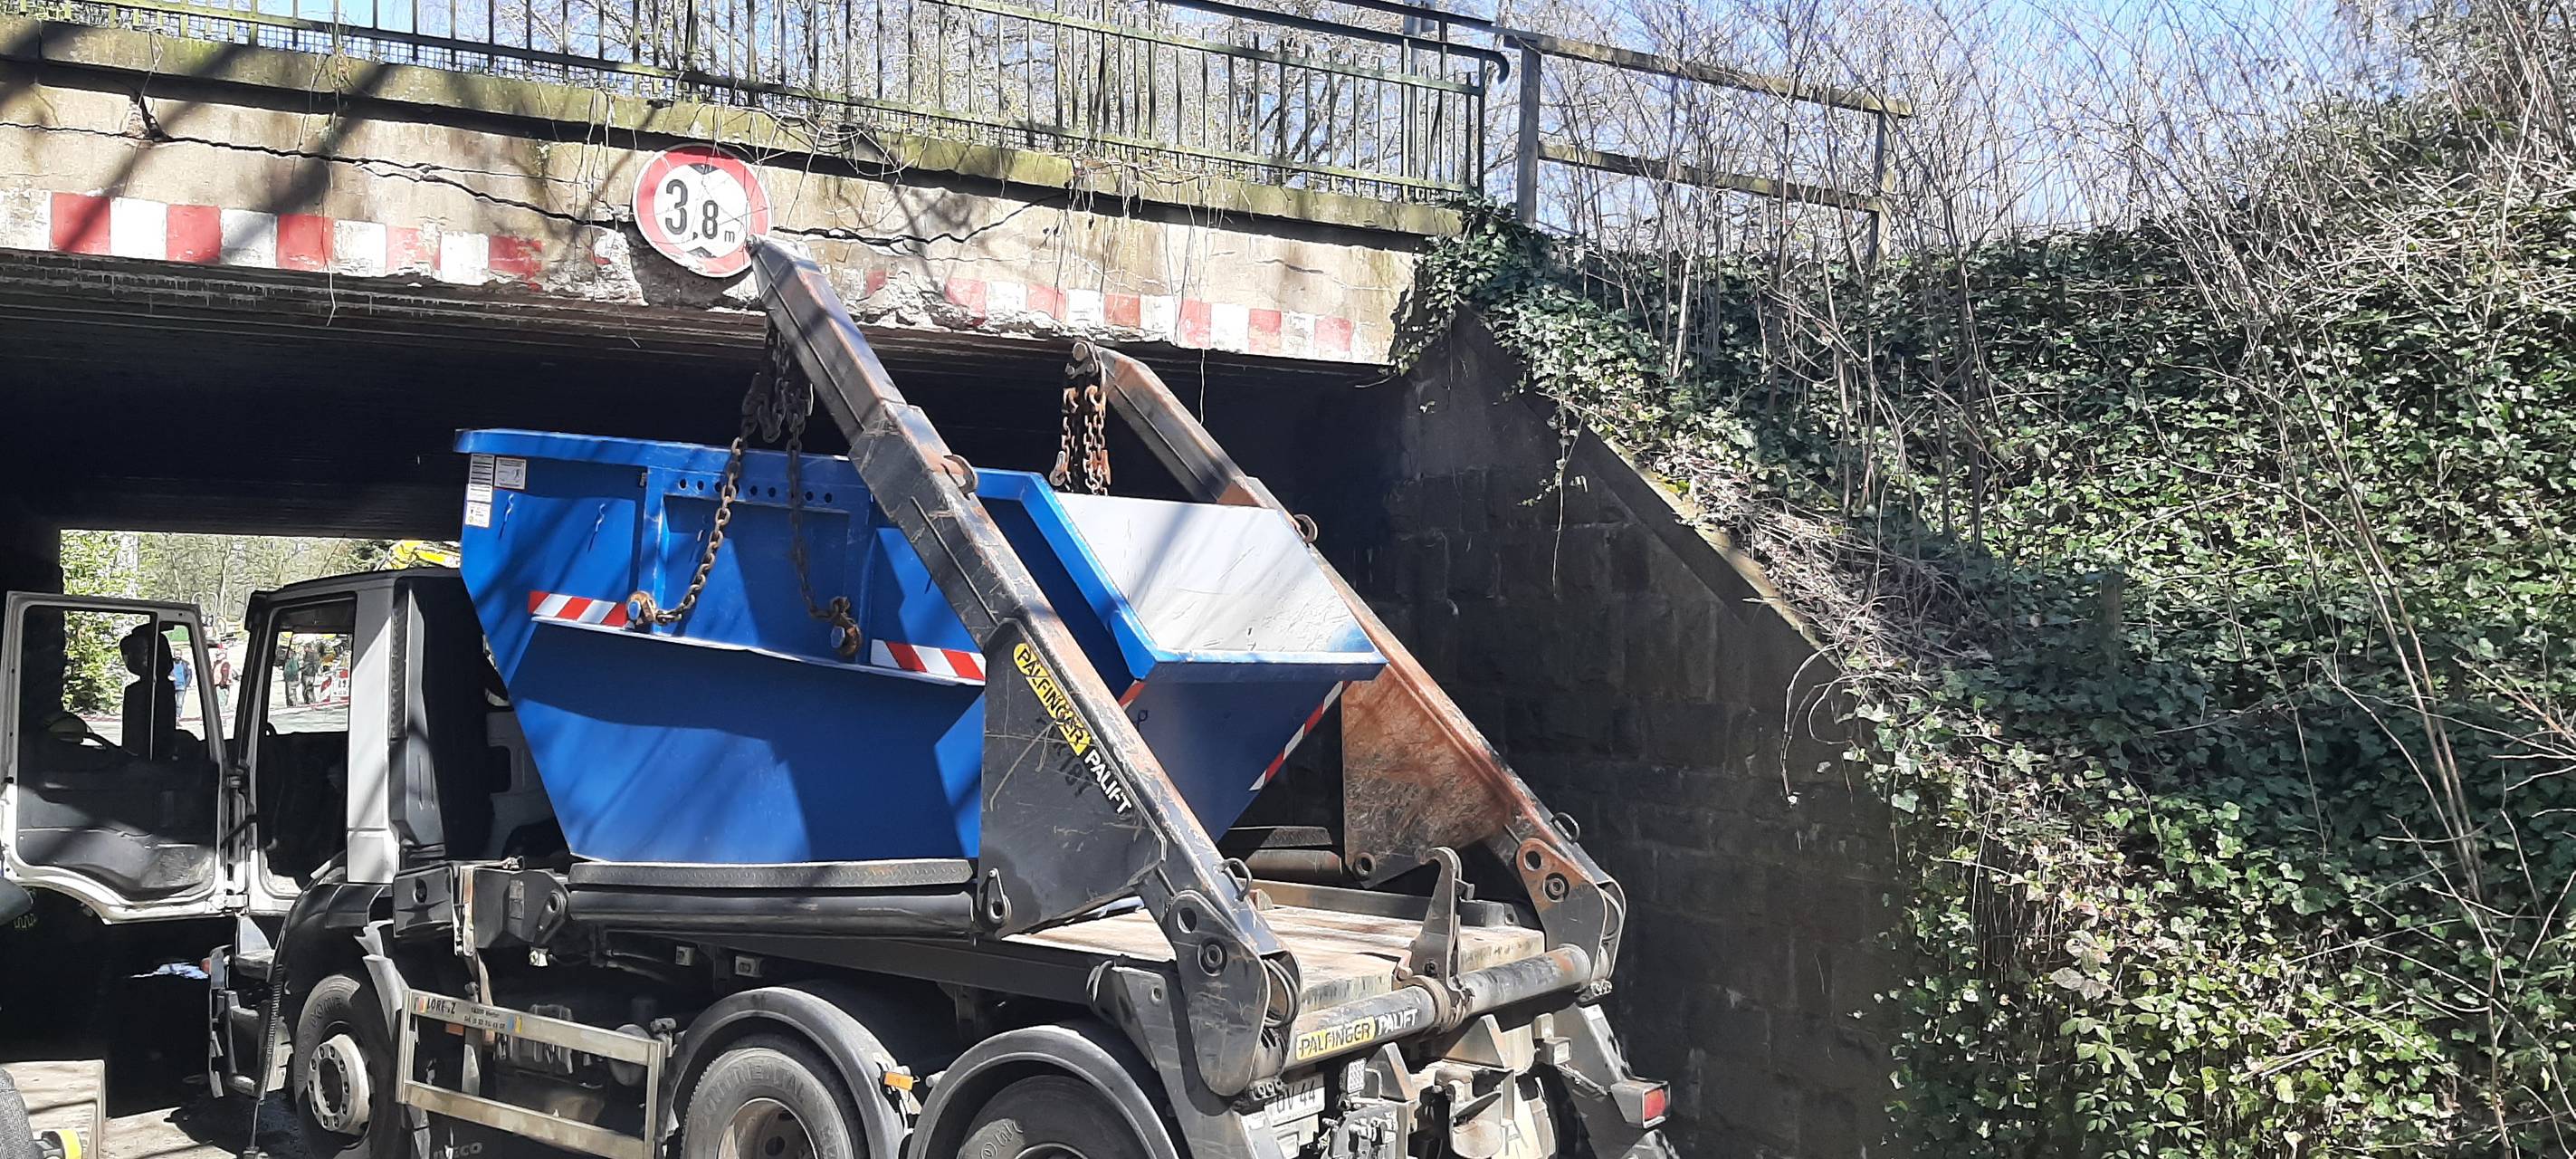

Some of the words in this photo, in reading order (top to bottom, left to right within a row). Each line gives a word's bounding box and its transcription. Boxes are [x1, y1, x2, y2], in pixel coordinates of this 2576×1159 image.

[665, 178, 719, 241] 3,8
[723, 229, 736, 244] m
[1016, 647, 1086, 747] PALFINGER
[1084, 748, 1133, 814] PALIFT
[1300, 1021, 1371, 1058] PALFINGER
[1375, 1008, 1418, 1036] PALIFT
[1299, 1079, 1316, 1106] 44
